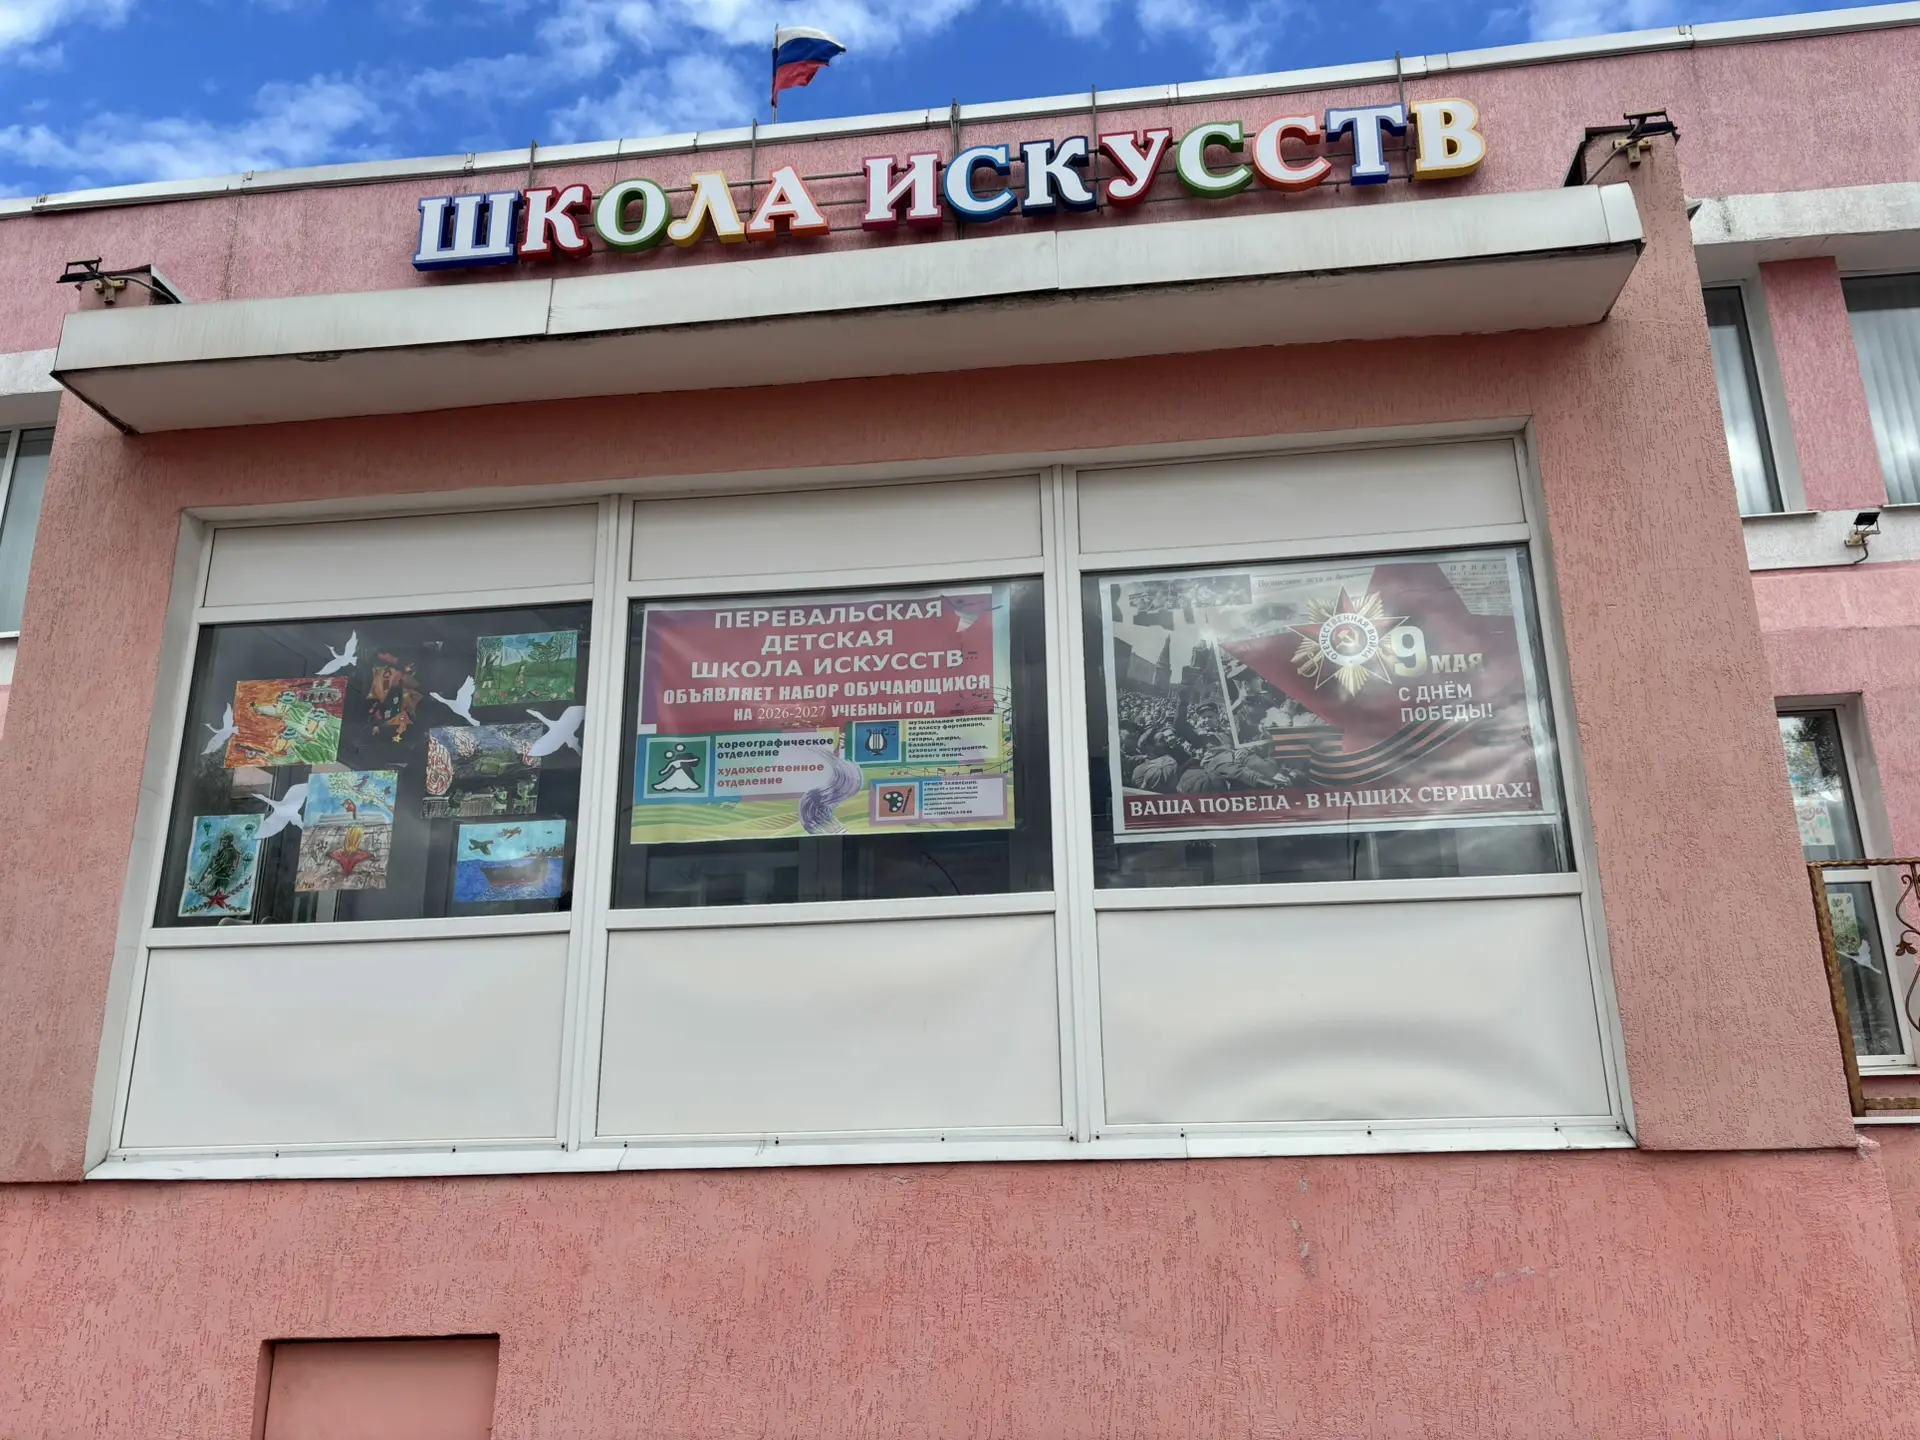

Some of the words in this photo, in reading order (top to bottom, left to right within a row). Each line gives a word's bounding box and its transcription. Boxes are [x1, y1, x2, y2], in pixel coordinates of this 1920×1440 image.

[413, 166, 830, 272] ШКОЛА
[862, 97, 1486, 231] ИСКУССТВ
[714, 600, 942, 629] ПЕРЕВАЛЬСКАЯ
[760, 629, 894, 656] ДЕТСКАЯ
[1390, 625, 1428, 678] 9
[1430, 653, 1485, 674] МАЯ
[691, 658, 803, 679] ШКОЛА
[813, 650, 963, 675] ИСКУССТВ
[663, 686, 774, 705] ОБЪЯВЛЯЕТ
[779, 683, 839, 701] НАБОР
[843, 674, 991, 697] ОБУЧАЮЩИХСЯ
[1398, 687, 1411, 701] С
[1416, 681, 1473, 703] ДНЁМ
[733, 708, 753, 722] НА
[757, 705, 826, 720] 2026-2027
[831, 700, 902, 718] УЧЕБНЫЙ
[905, 701, 935, 716] ГОД
[1400, 702, 1494, 723] ПОБЕДЫ!
[717, 738, 834, 750] хореографическое
[717, 749, 780, 760] отделение
[717, 764, 824, 777] художественное
[717, 777, 783, 788] отделение
[1130, 798, 1196, 818] ВАША
[1199, 797, 1291, 815] ПОБЕДА
[1307, 792, 1321, 809] В
[1325, 788, 1413, 809] НАШИХ
[1417, 782, 1533, 805] СЕРДЦАХ!
